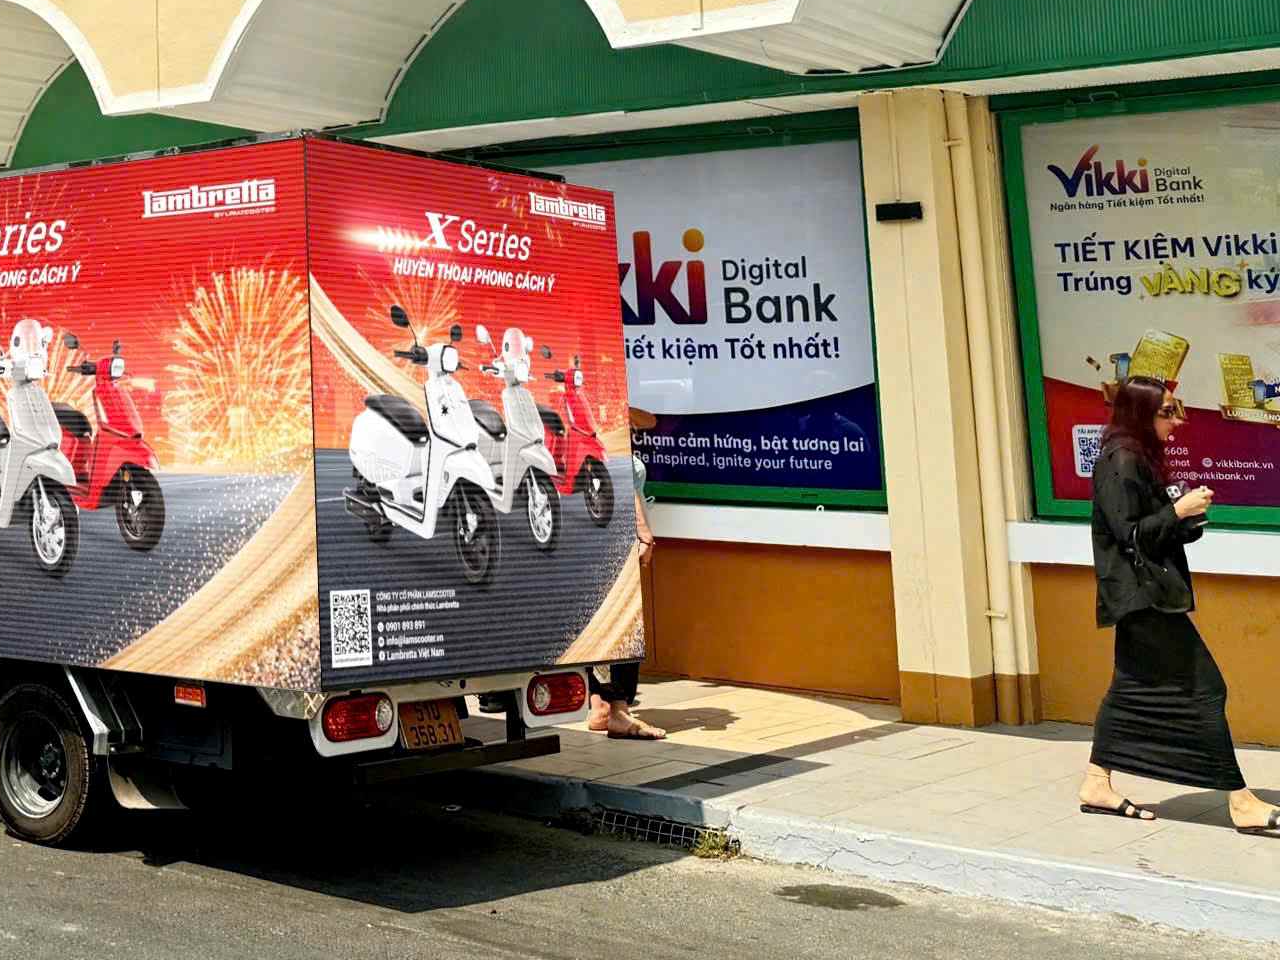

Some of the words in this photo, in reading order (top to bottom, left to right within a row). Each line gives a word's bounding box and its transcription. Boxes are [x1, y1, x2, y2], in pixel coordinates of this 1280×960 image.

[1047, 144, 1150, 198] Vikki
[1153, 166, 1191, 178] Digital
[1155, 175, 1204, 192] Bank
[419, 211, 460, 250] X
[458, 219, 532, 261] Series
[1054, 231, 1116, 264] TIẾT
[1124, 232, 1196, 266] KIỆM
[1201, 232, 1278, 257] Vikki
[29, 264, 68, 285] CÁCH
[437, 263, 473, 286] THOẠI
[474, 269, 513, 289] PHONG
[516, 271, 545, 291] CÁCH
[721, 255, 807, 286] Digital
[1056, 270, 1132, 296] Trúng
[1140, 263, 1242, 298] VÀNG
[723, 283, 839, 324] Bank
[625, 334, 655, 360] iết
[662, 337, 719, 366] kiệm
[724, 333, 767, 360] Tốt
[772, 333, 841, 360] nhất!
[632, 432, 675, 451] Chạm
[678, 432, 710, 448] cảm
[713, 432, 757, 452] hứng,
[760, 434, 789, 455] bật
[791, 436, 840, 455] tương
[843, 436, 864, 453] lai
[652, 451, 710, 468] inspired,
[712, 453, 751, 469] ignite
[755, 456, 785, 471] your
[789, 455, 833, 470] future
[1215, 458, 1275, 469] vikkibank.vn
[387, 649, 417, 661] Lambretta
[431, 647, 445, 657] Nam
